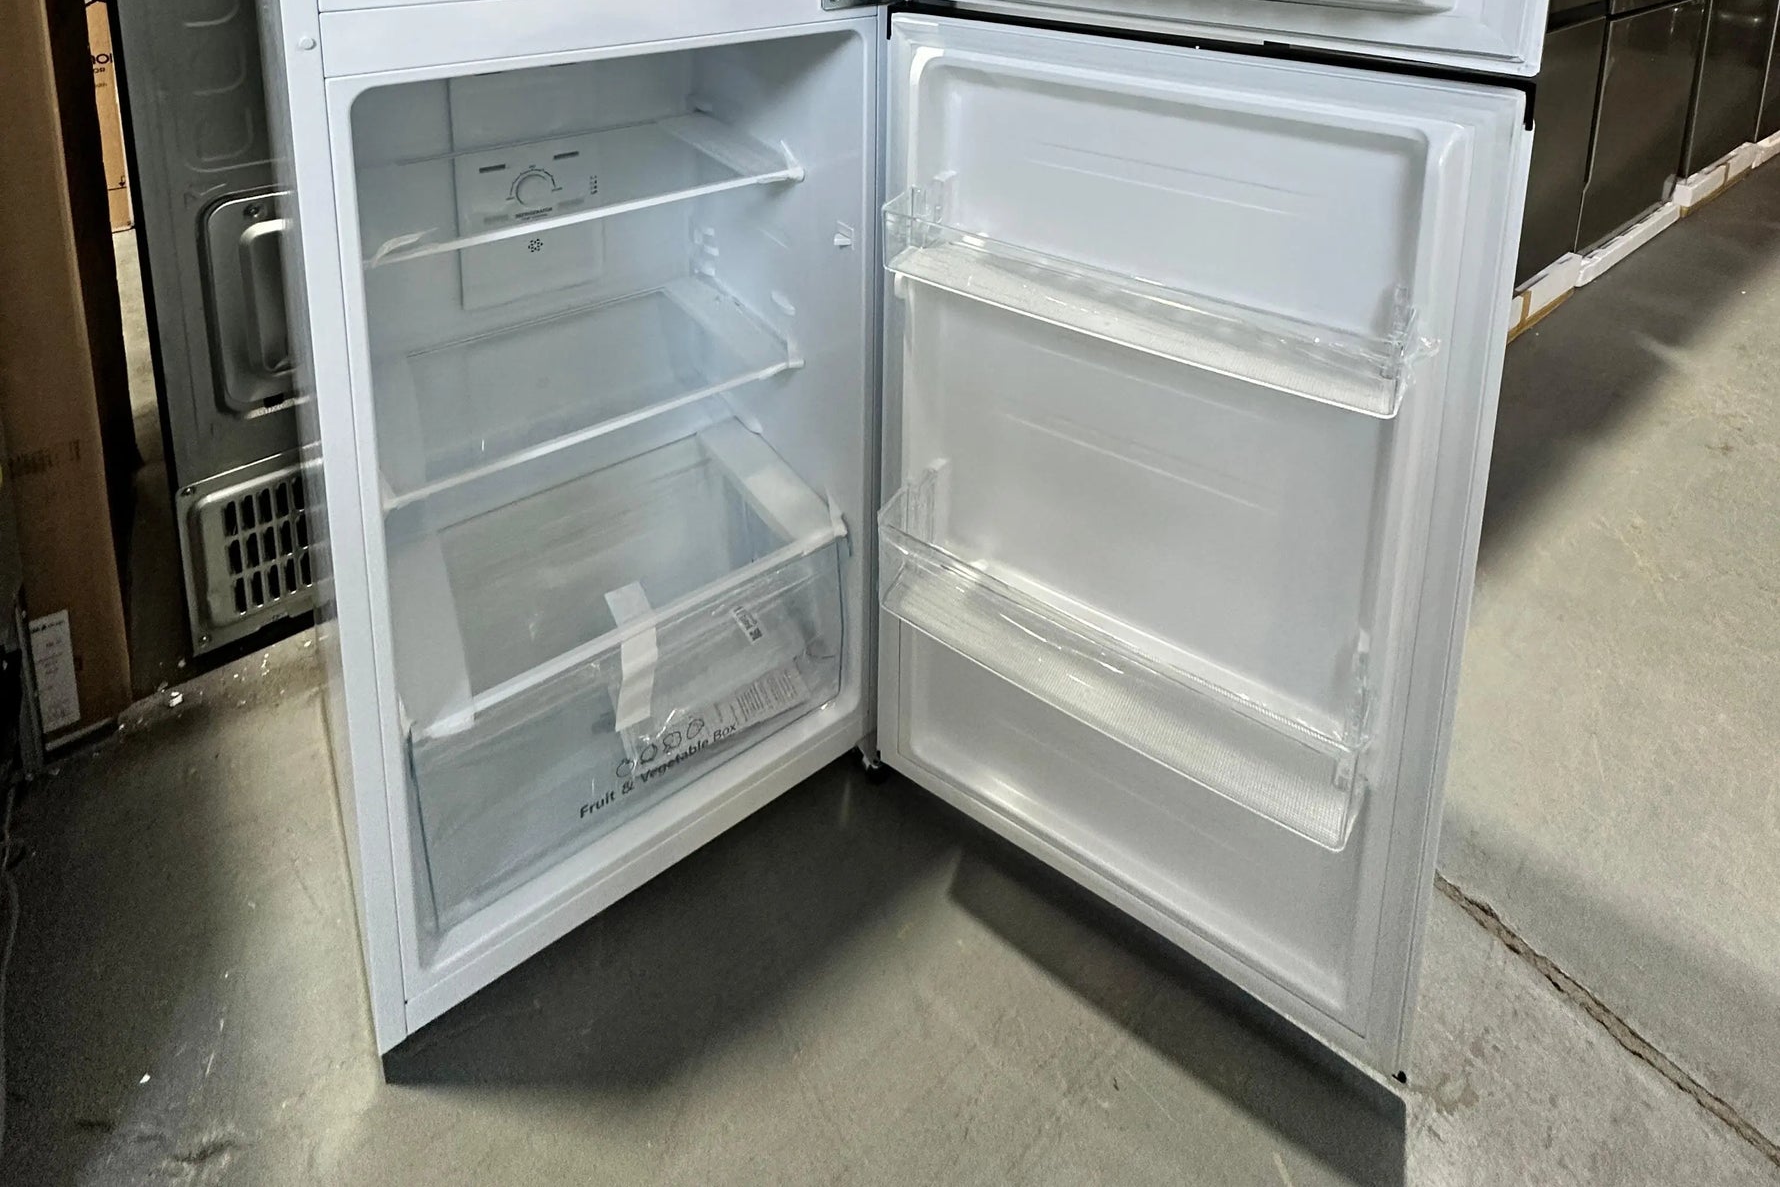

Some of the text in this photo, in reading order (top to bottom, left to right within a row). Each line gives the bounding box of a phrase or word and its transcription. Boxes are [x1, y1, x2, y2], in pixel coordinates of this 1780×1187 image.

[580, 723, 737, 819] Fruit & Vegetable Box
